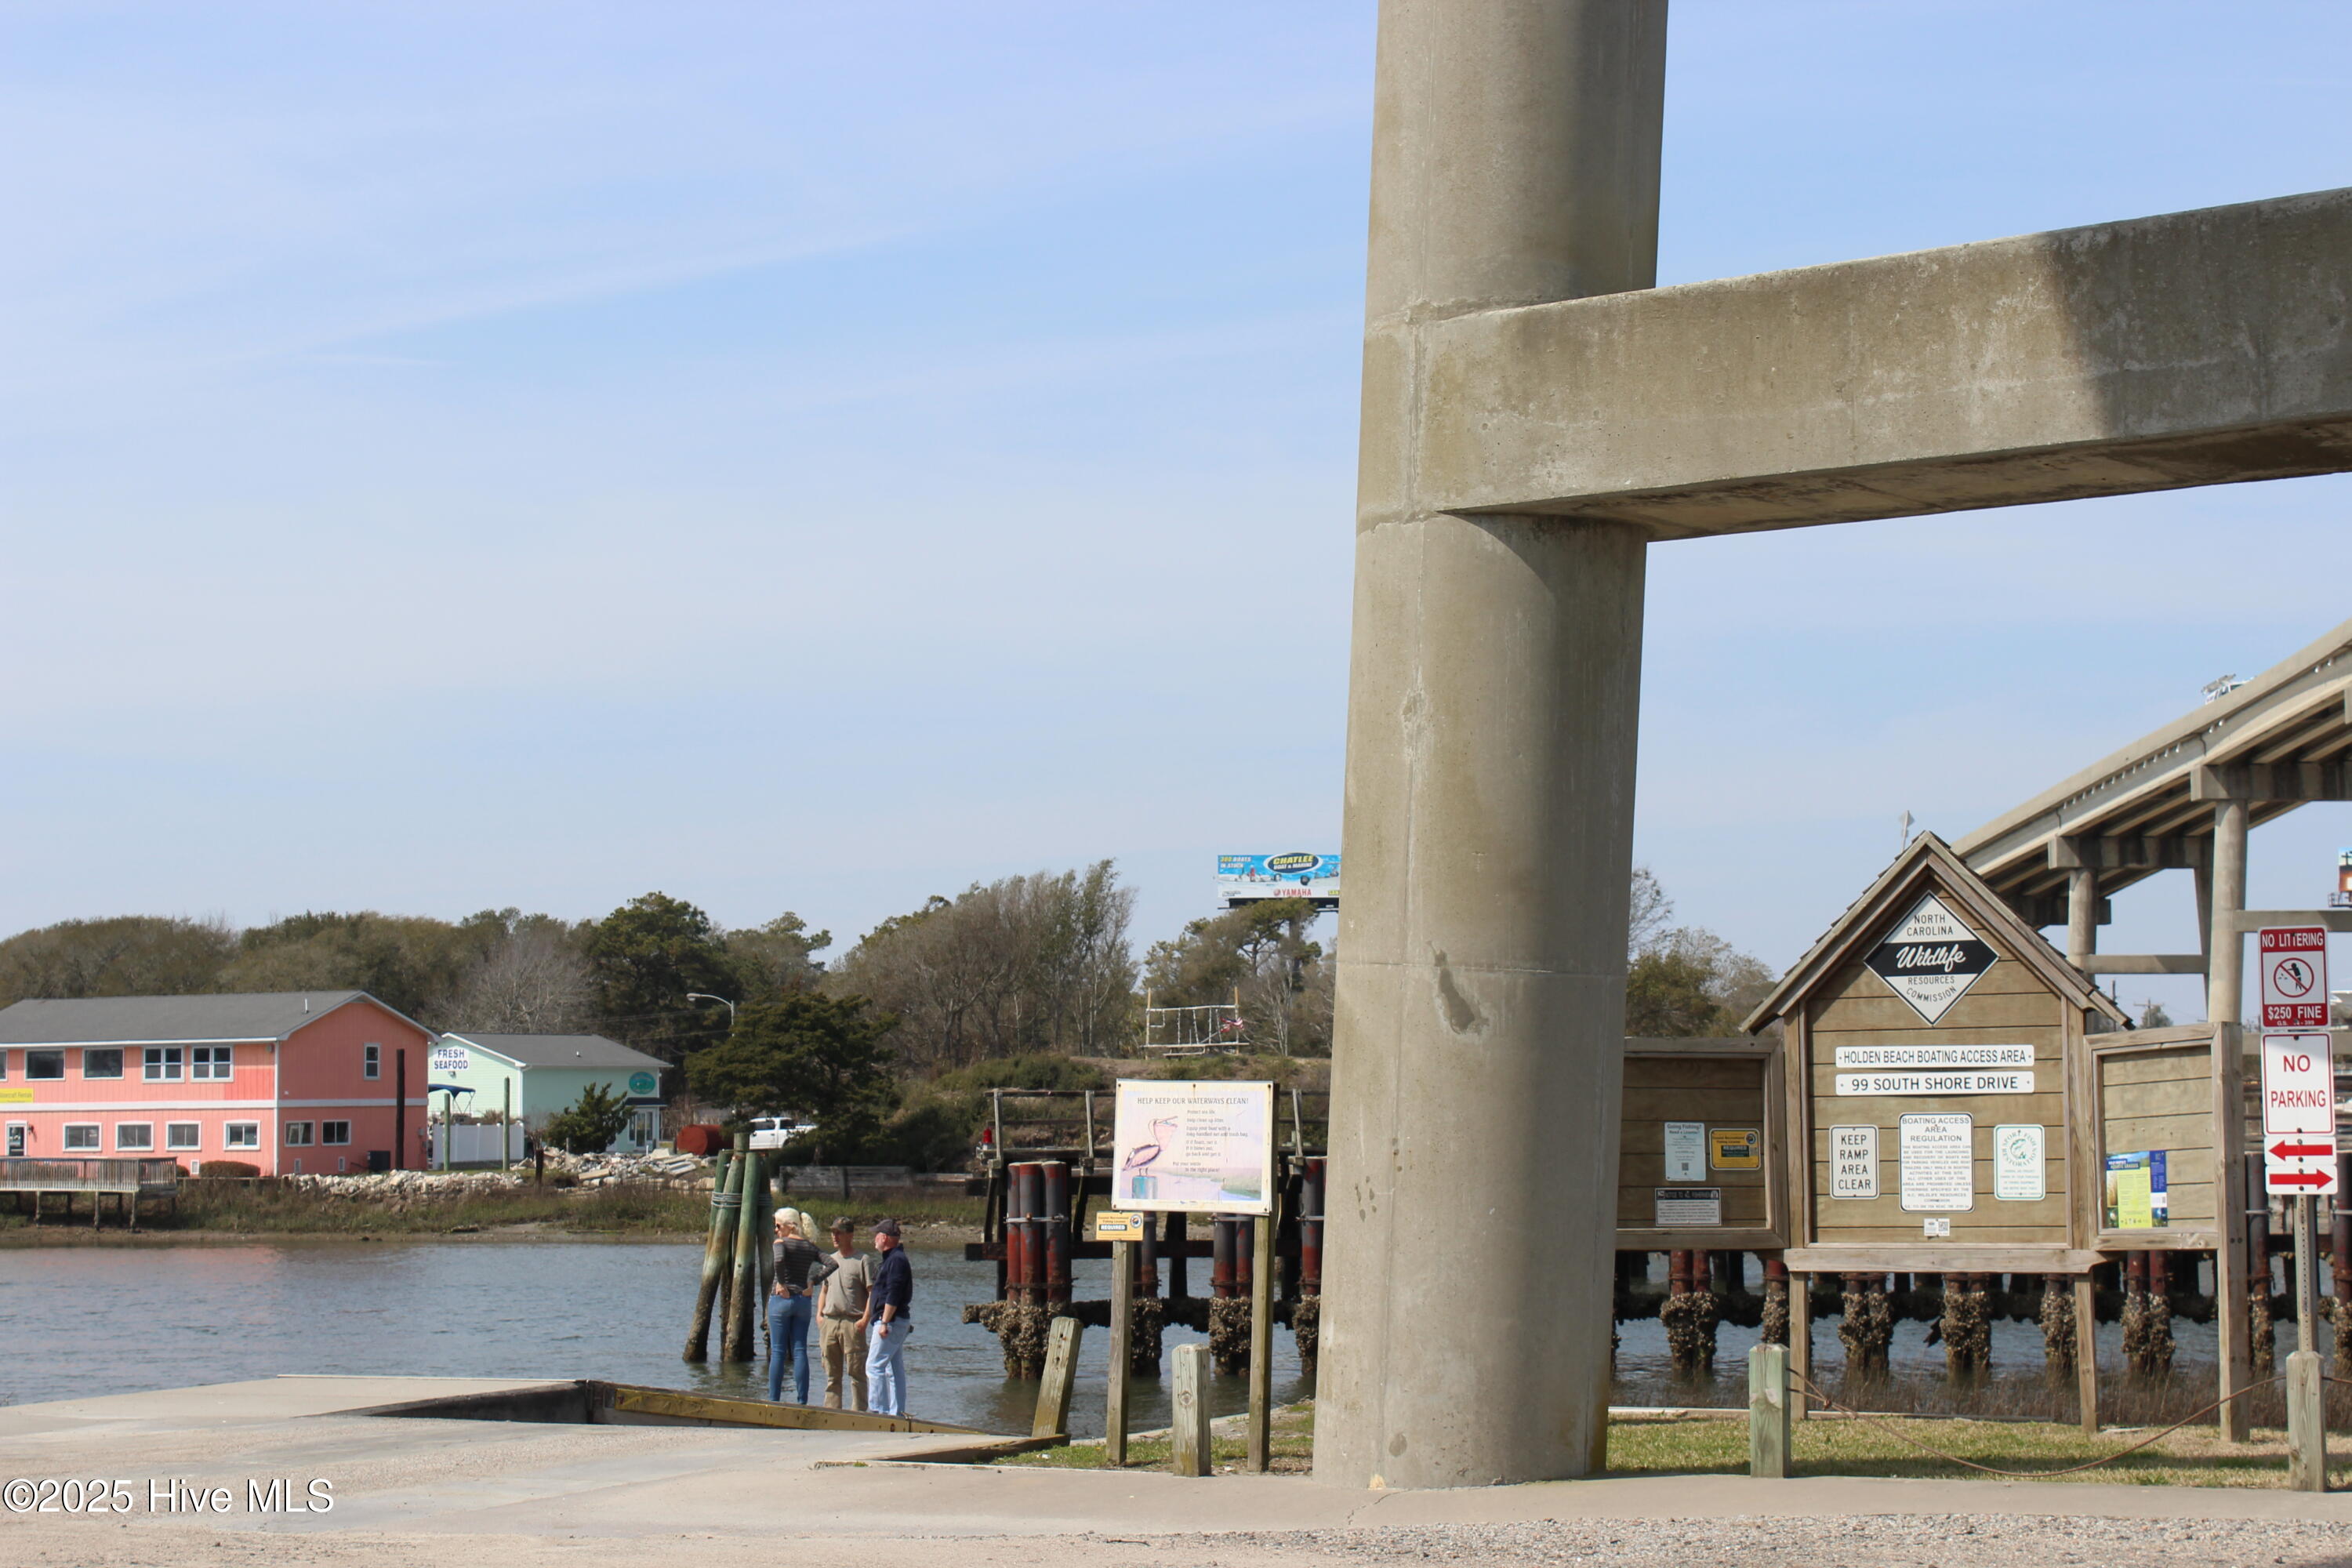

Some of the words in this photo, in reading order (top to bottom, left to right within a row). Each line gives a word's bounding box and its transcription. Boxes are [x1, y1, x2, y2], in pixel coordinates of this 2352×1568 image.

[1273, 855, 1314, 864] CHATLEE
[1915, 914, 1945, 924] NORTH
[1907, 926, 1954, 936] CAROLINA
[2262, 934, 2274, 947] NO
[2279, 933, 2324, 947] LITTERING
[1896, 944, 1966, 972] Wildlife
[1907, 975, 1955, 985] RESOURCES
[1906, 985, 1957, 1002] COMMISSION
[2267, 1006, 2292, 1020] $250
[2297, 1005, 2322, 1018] FINE
[437, 1049, 465, 1058] FRESH
[1844, 1051, 1880, 1063] HOLDEN
[1883, 1051, 1915, 1063] BEACH
[1918, 1051, 1958, 1063] BOATING
[1960, 1050, 1998, 1063] ACCESS
[1999, 1050, 2026, 1062] AREA
[434, 1060, 469, 1069] SEAFOOD
[2283, 1054, 2310, 1073] NO
[1852, 1078, 1868, 1091] 99
[1874, 1077, 1919, 1091] SOUTH
[1925, 1077, 1972, 1090] SHORE
[1977, 1076, 2018, 1089] DRIVE
[2270, 1090, 2326, 1108] PARKING
[1841, 1134, 1867, 1145] KEEP
[1839, 1149, 1868, 1160] RAMP
[1841, 1164, 1868, 1174] AREA
[1838, 1179, 1871, 1190] CLEAR
